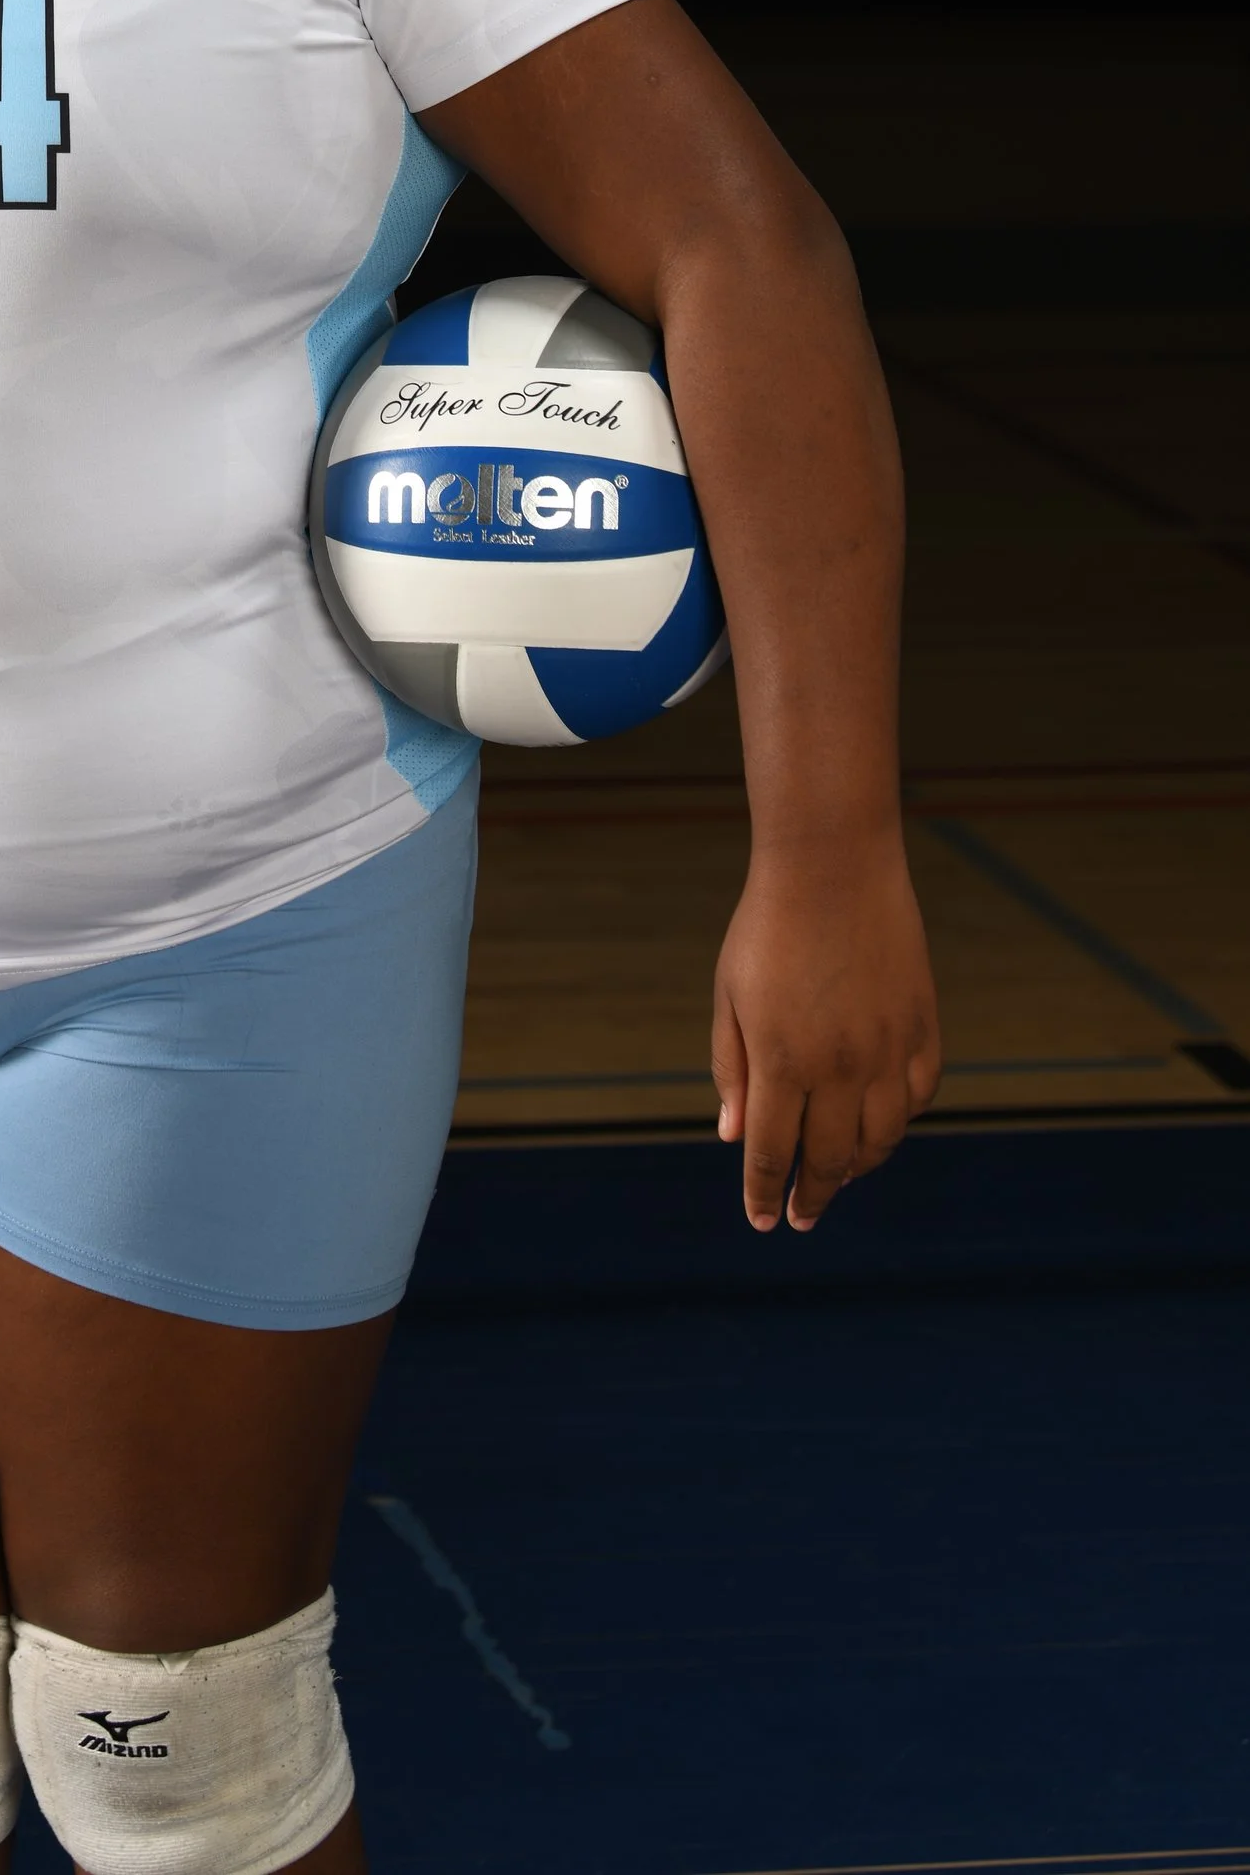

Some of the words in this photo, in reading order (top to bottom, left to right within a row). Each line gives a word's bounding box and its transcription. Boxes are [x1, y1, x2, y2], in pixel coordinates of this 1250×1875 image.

[380, 381, 483, 431] Super
[498, 380, 623, 431] Touch
[433, 527, 474, 543] Select
[481, 529, 536, 546] Leather
